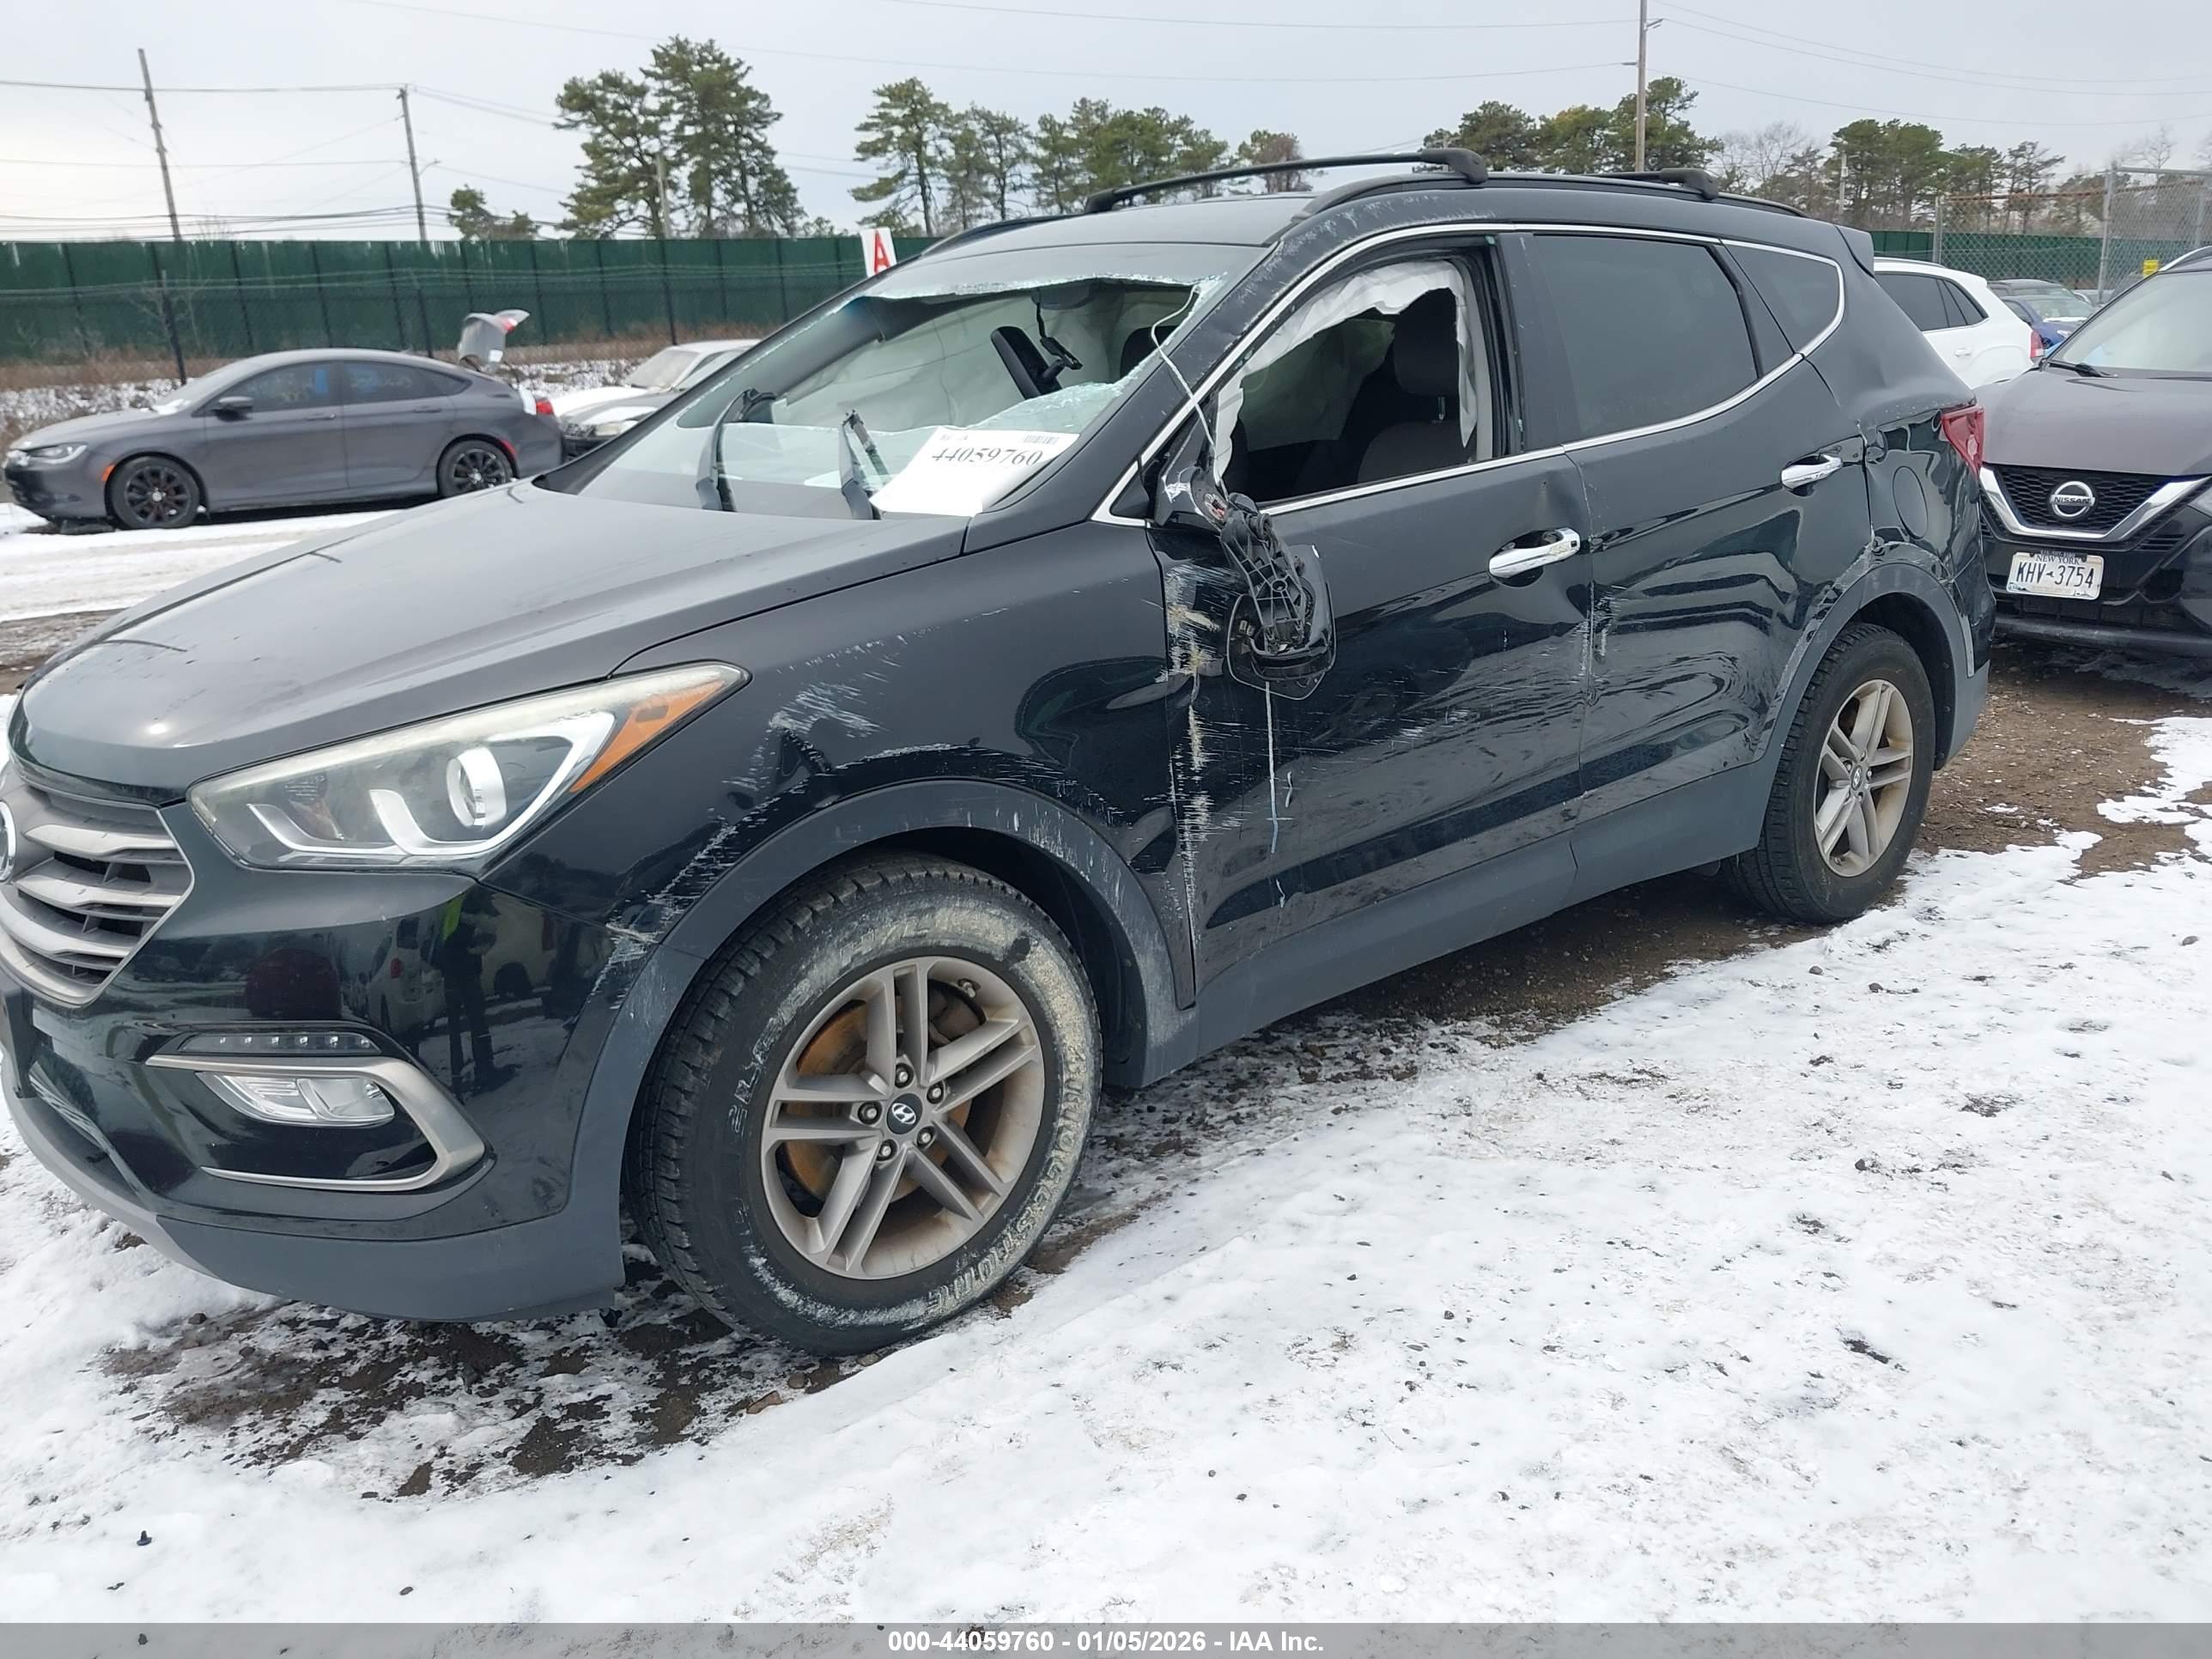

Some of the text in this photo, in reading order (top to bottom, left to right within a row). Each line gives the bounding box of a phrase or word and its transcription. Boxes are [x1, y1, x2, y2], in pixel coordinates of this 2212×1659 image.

[873, 228, 890, 274] A
[932, 447, 1043, 465] 44059760
[2035, 554, 2080, 565] NEW YORK
[2015, 562, 2094, 588] KHV 3754
